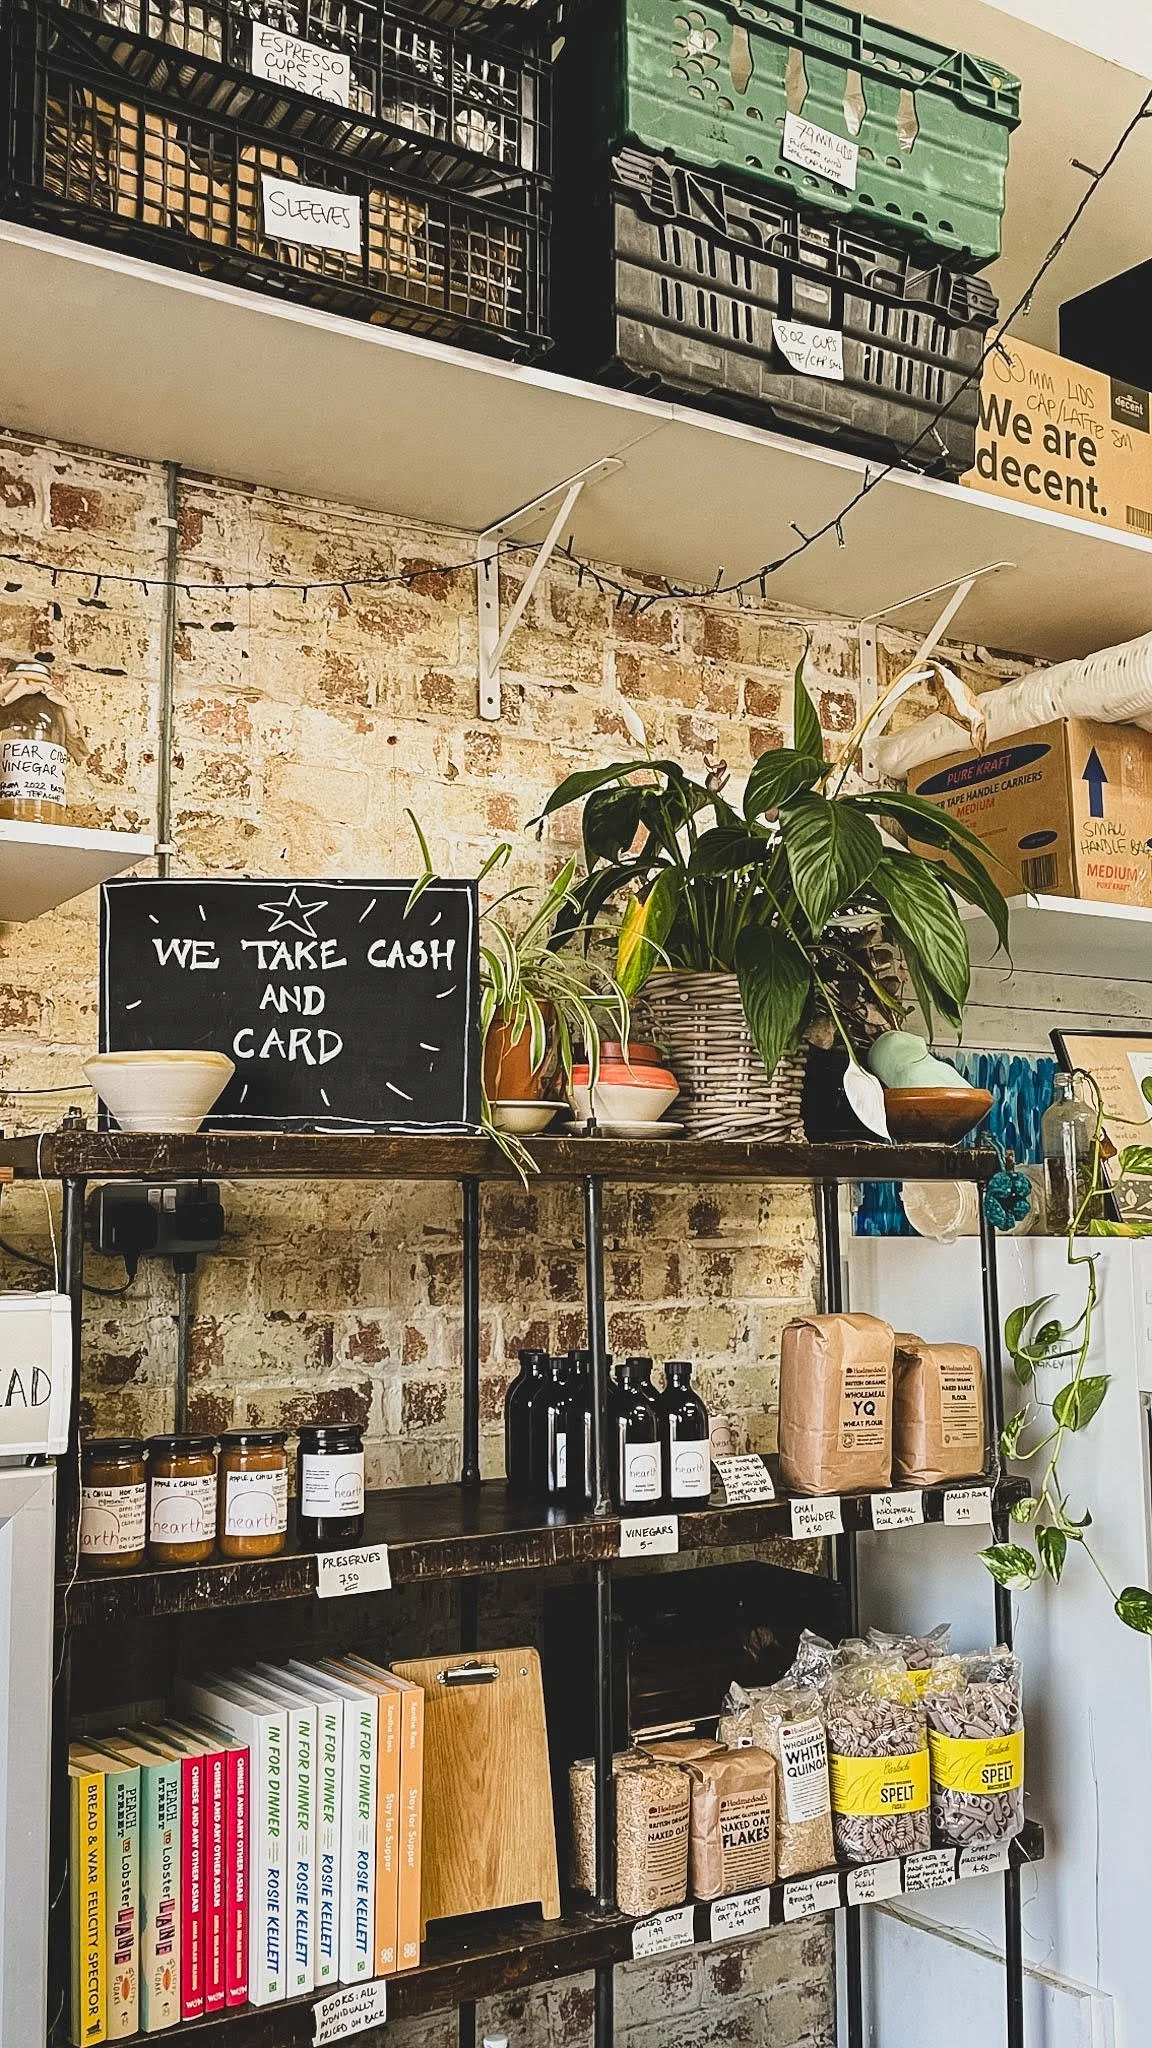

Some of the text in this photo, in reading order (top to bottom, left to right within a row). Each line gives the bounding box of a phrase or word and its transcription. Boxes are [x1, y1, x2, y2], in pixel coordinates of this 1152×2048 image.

[259, 32, 343, 74] ESPRESSO
[265, 53, 306, 77] CUPS
[268, 191, 350, 228] SLEEVES
[812, 335, 837, 352] CUPS
[1068, 378, 1094, 408] LIDS
[1115, 396, 1144, 416] decent
[978, 394, 1096, 466] We are
[976, 441, 1107, 516] decent.
[2, 744, 44, 760] PEAR
[2, 760, 58, 778] VINEGAR
[947, 754, 1012, 786] PURE KRAFT
[24, 782, 46, 790] 2022
[947, 771, 1044, 808] TAPE HANDLE CARRIERS
[956, 798, 995, 818] MEDIUM
[1087, 864, 1138, 880] MEDIUM
[152, 937, 456, 971] WE TAKE CASH
[258, 984, 326, 1016] AND
[232, 1028, 344, 1066] CARD
[845, 1390, 886, 1398] WHOLEMEAL
[853, 1400, 876, 1416] YQ
[230, 1474, 248, 1482] APPLE
[794, 1503, 814, 1514] CHAI
[880, 1496, 892, 1506] YQ
[153, 1518, 205, 1534] hearth
[228, 1512, 277, 1528] hearth
[800, 1512, 836, 1524] POWDER
[896, 1516, 914, 1524] 4.99
[626, 1526, 674, 1538] VINEGARS
[806, 1525, 822, 1534] 4.50
[322, 1552, 381, 1569] PRESERVES
[339, 1574, 360, 1586] 7.50
[786, 1741, 825, 1765] WHITE
[298, 1720, 310, 1830] IN FOR DINNER
[323, 1715, 336, 1824] IN FOR DINNER
[358, 1712, 372, 1820] IN FOR DINNER
[787, 1756, 826, 1778] QUINOA
[982, 1764, 1014, 1784] SPELT
[268, 1726, 280, 1838] IN FOR DINNER
[166, 1780, 177, 1822] PEACH
[385, 1794, 394, 1816] Stay
[880, 1785, 914, 1803] SPELT
[126, 1788, 136, 1829] PEACH
[720, 1814, 740, 1822] ORGANIC
[742, 1810, 759, 1818] GLUTEN
[407, 1789, 417, 1868] Stay for Supper
[649, 1820, 670, 1829] BRITISH
[720, 1815, 770, 1834] NAKED OAT
[648, 1830, 674, 1842] NAKED
[722, 1826, 770, 1849] FLAKES
[384, 1834, 394, 1872] Supper
[122, 1854, 132, 1907] Lobster
[162, 1846, 172, 1898] Lobster
[854, 1868, 876, 1880] SPELT
[88, 1784, 98, 2016] BREAD & WAR FELICITY SPECTOR
[320, 1854, 334, 1958] ROSIE KELLETT
[356, 1850, 368, 1954] ROSIE KELLETT
[744, 1896, 762, 1906] FREE
[266, 1868, 280, 1974] ROSIE KELLETT
[296, 1862, 308, 1967] ROSIE KELLETT
[634, 1918, 662, 1932] NAKED
[115, 1906, 134, 1965] LANE
[156, 1898, 176, 1956] LANE
[648, 1926, 664, 1938] 1.99
[322, 1988, 378, 2016] BOOKS: ALL
[320, 2010, 384, 2042] PRICED ON BACK
